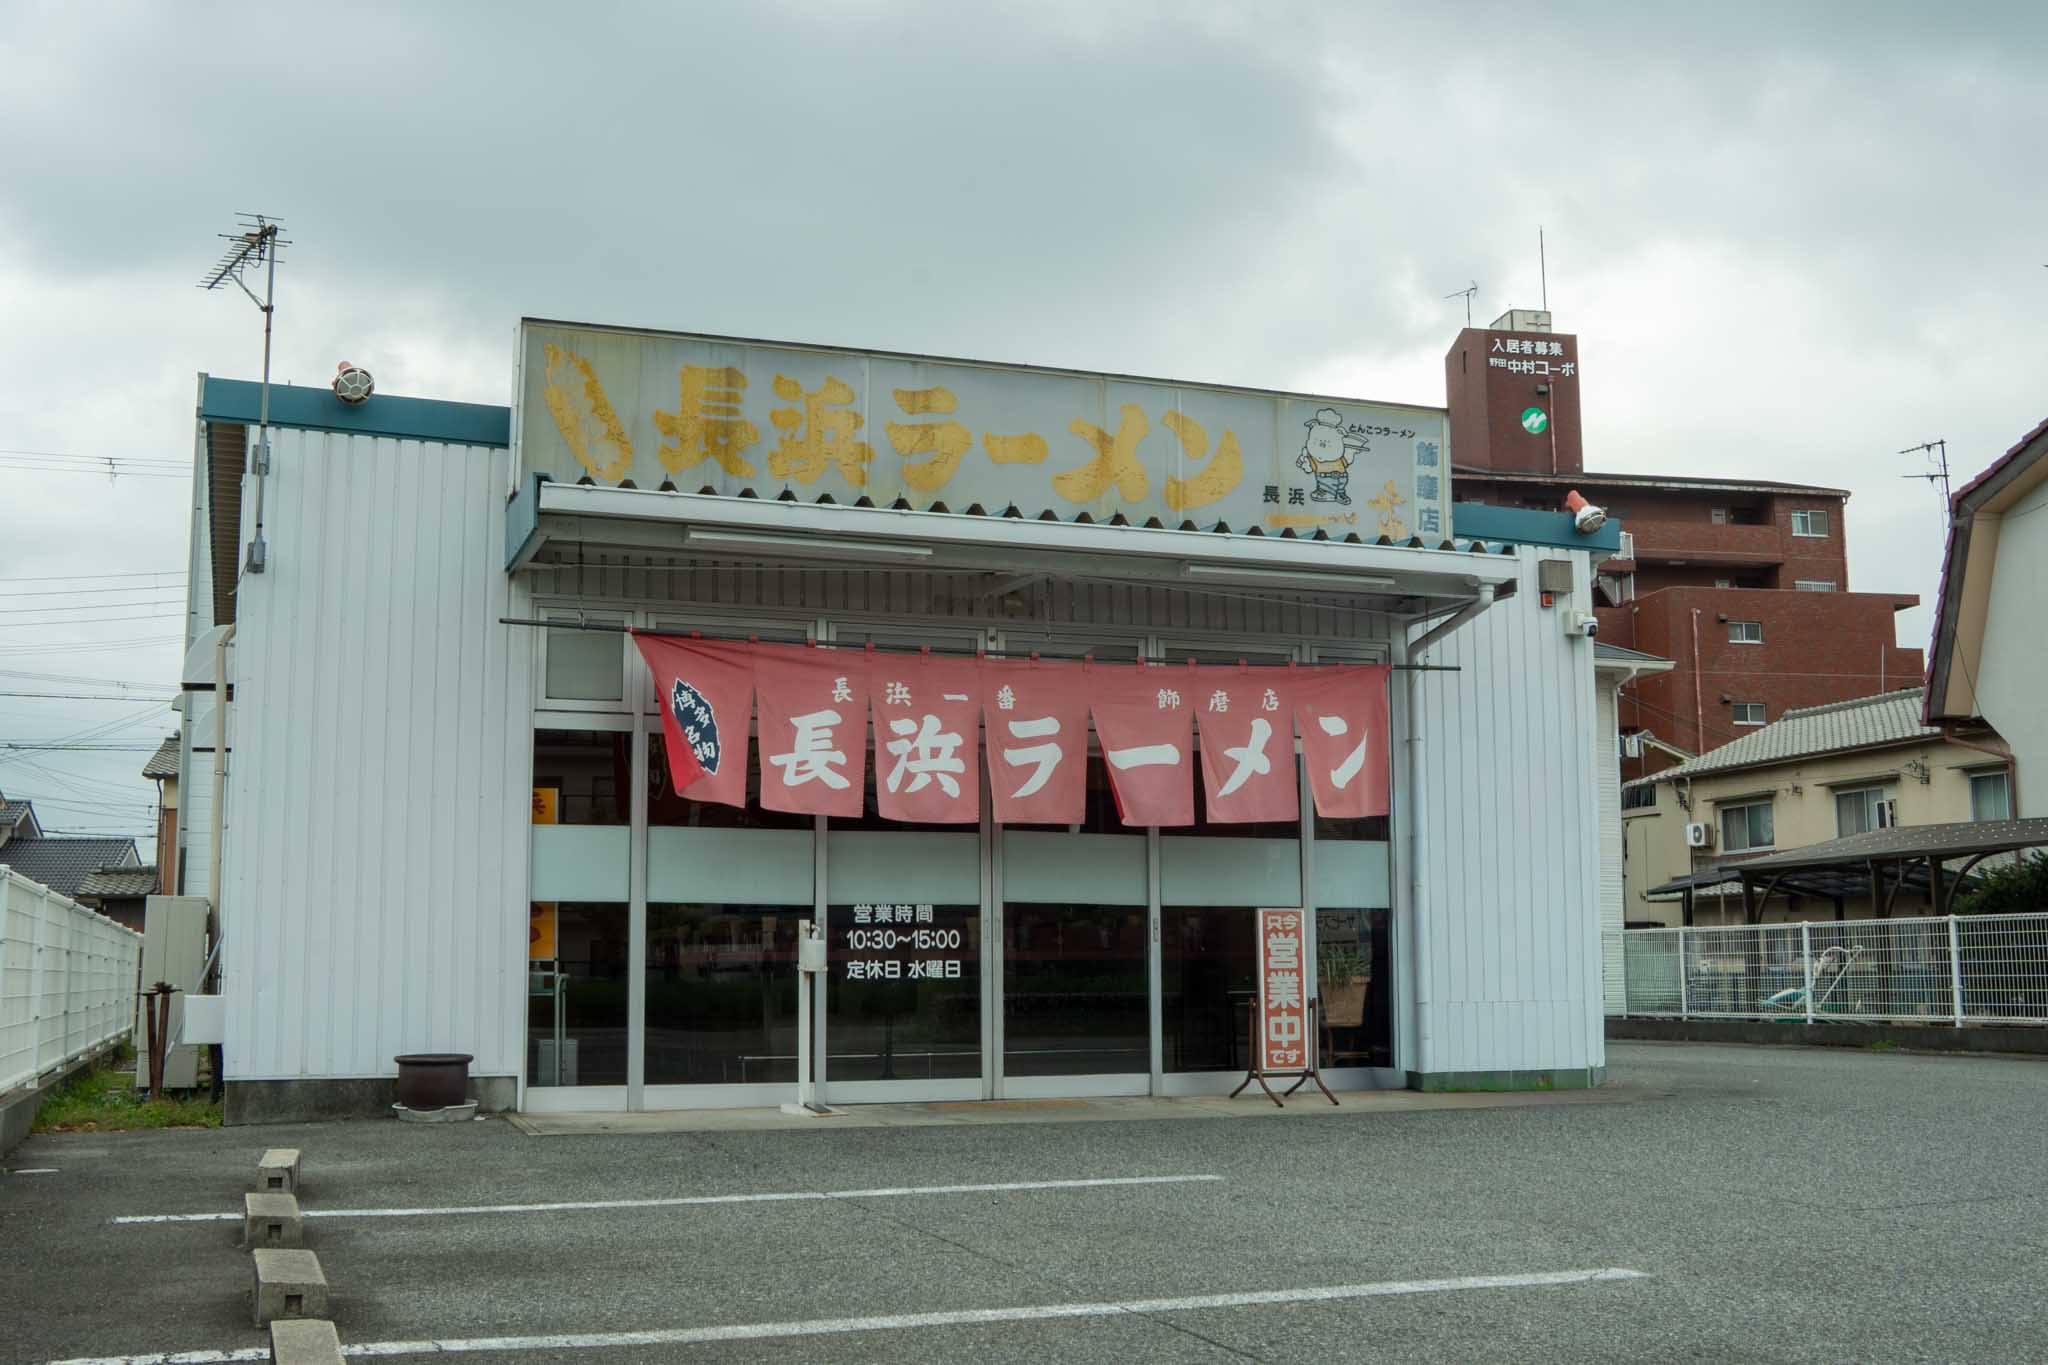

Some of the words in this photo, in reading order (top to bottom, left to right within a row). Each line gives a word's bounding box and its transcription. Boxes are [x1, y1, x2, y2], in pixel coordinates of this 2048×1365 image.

[1492, 338, 1563, 356] 入居者募集
[652, 363, 1244, 511] 長浜ラーメン
[1348, 423, 1416, 439] とんこつラーメン
[1262, 485, 1305, 505] 長浜
[832, 677, 1016, 710] 長浜一番
[1157, 688, 1280, 713] 飾磨店
[674, 690, 716, 762] 博多名物
[770, 710, 1367, 799] 長浜ラーメン
[854, 904, 933, 923] 営業時間
[1267, 915, 1299, 930] 只今
[847, 960, 901, 979] 定休日
[907, 960, 961, 978] 水曜日
[1267, 932, 1301, 1048] 営業中
[1270, 1049, 1301, 1064] です
